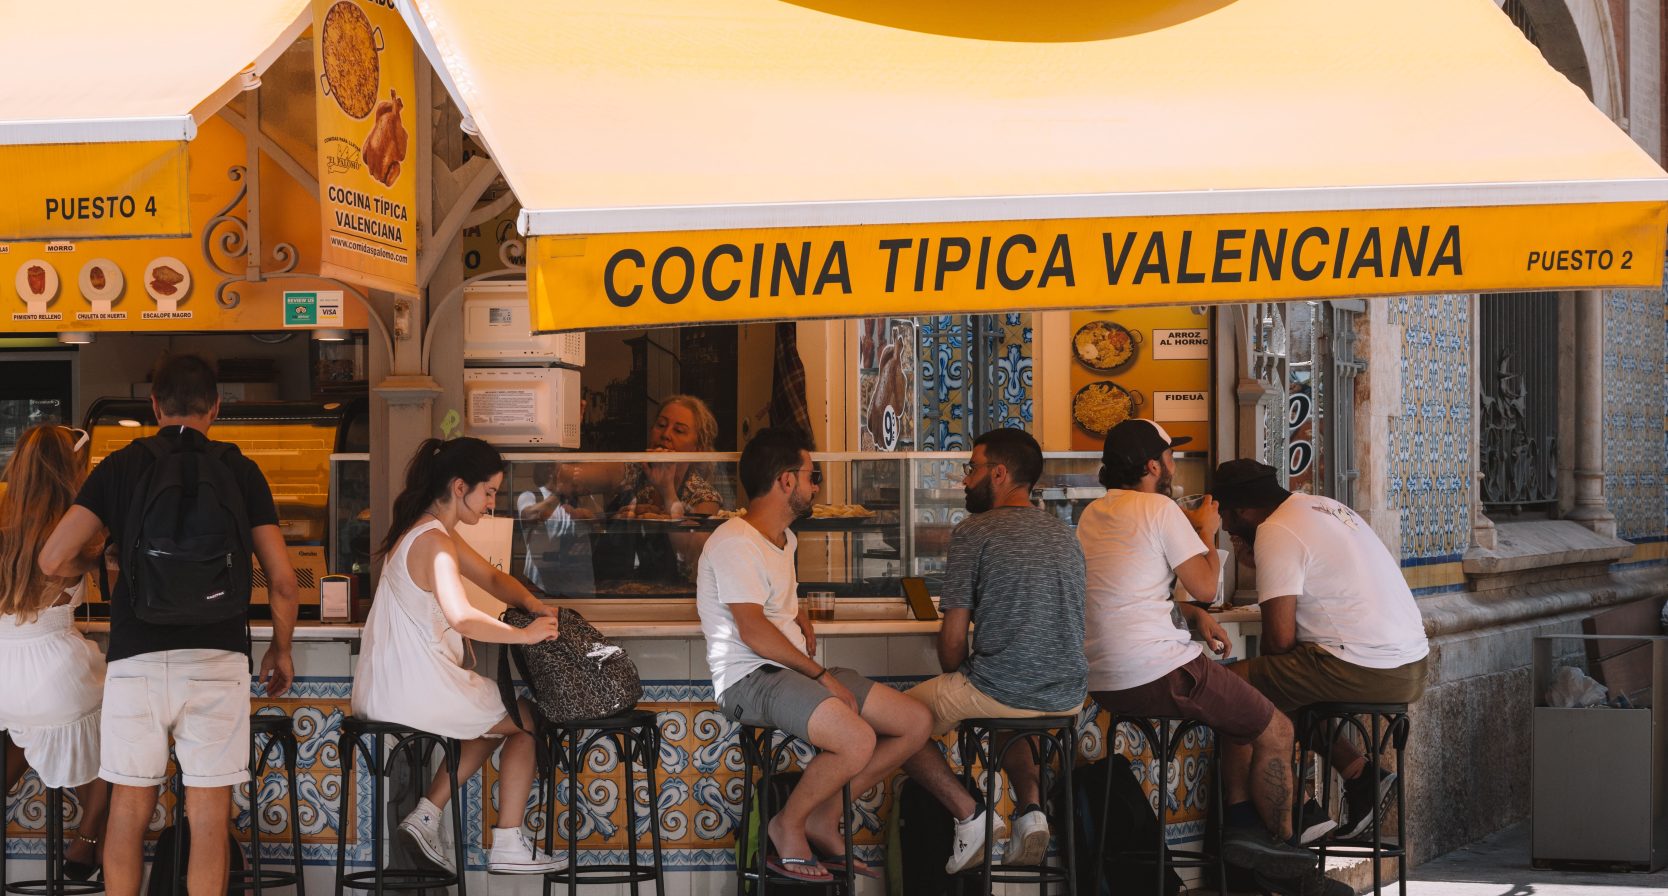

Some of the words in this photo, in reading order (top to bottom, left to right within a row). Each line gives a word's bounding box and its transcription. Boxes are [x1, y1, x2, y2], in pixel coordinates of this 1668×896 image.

[46, 195, 136, 220] PUESTO
[145, 196, 157, 217] 4
[328, 186, 371, 211] COCINA
[374, 196, 408, 221] TÍPICA
[335, 211, 402, 242] VALENCIANA
[331, 237, 408, 264] www.comidaspalomo.com
[1527, 249, 1615, 272] PUESTO
[1620, 249, 1633, 270] 2
[603, 239, 853, 307] COCINA
[878, 233, 1076, 293] TIPICA
[1102, 224, 1463, 286] VALENCIANA
